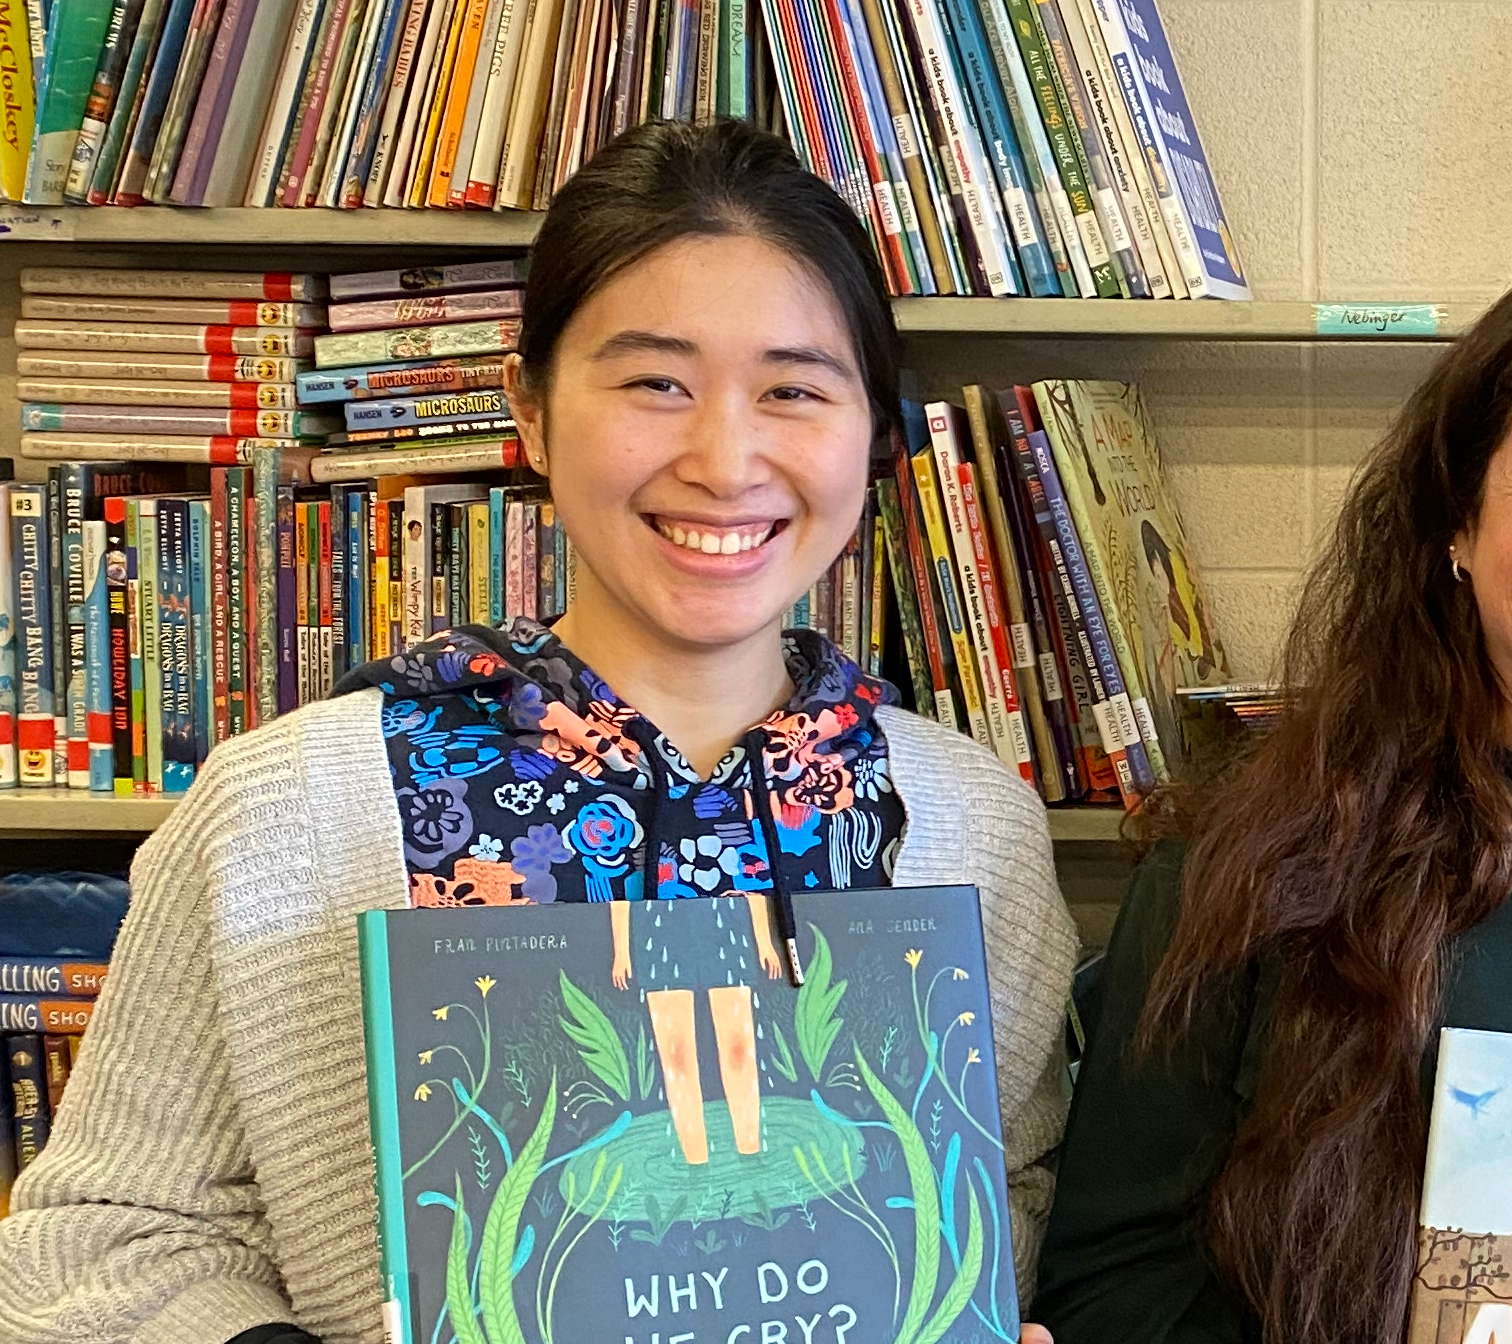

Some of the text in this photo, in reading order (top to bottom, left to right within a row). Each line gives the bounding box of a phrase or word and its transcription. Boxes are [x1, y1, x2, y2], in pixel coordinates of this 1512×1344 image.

[731, 3, 744, 57] DREAM
[491, 36, 506, 76] PIGS
[1014, 203, 1031, 241] HEALTH
[306, 367, 455, 393] HANSEN MICROSAURS
[353, 394, 501, 420] HANSEN MICROSAURS
[15, 499, 32, 511] #3
[939, 450, 963, 534] Daron Roberts
[19, 523, 44, 713] CHITTY CHITTY BANG BANG
[143, 579, 155, 663] STUART LITTLE
[434, 935, 569, 953] FRAN PINTADERA
[848, 916, 937, 935] ANA SENDER
[624, 1260, 829, 1318] WHY DO
